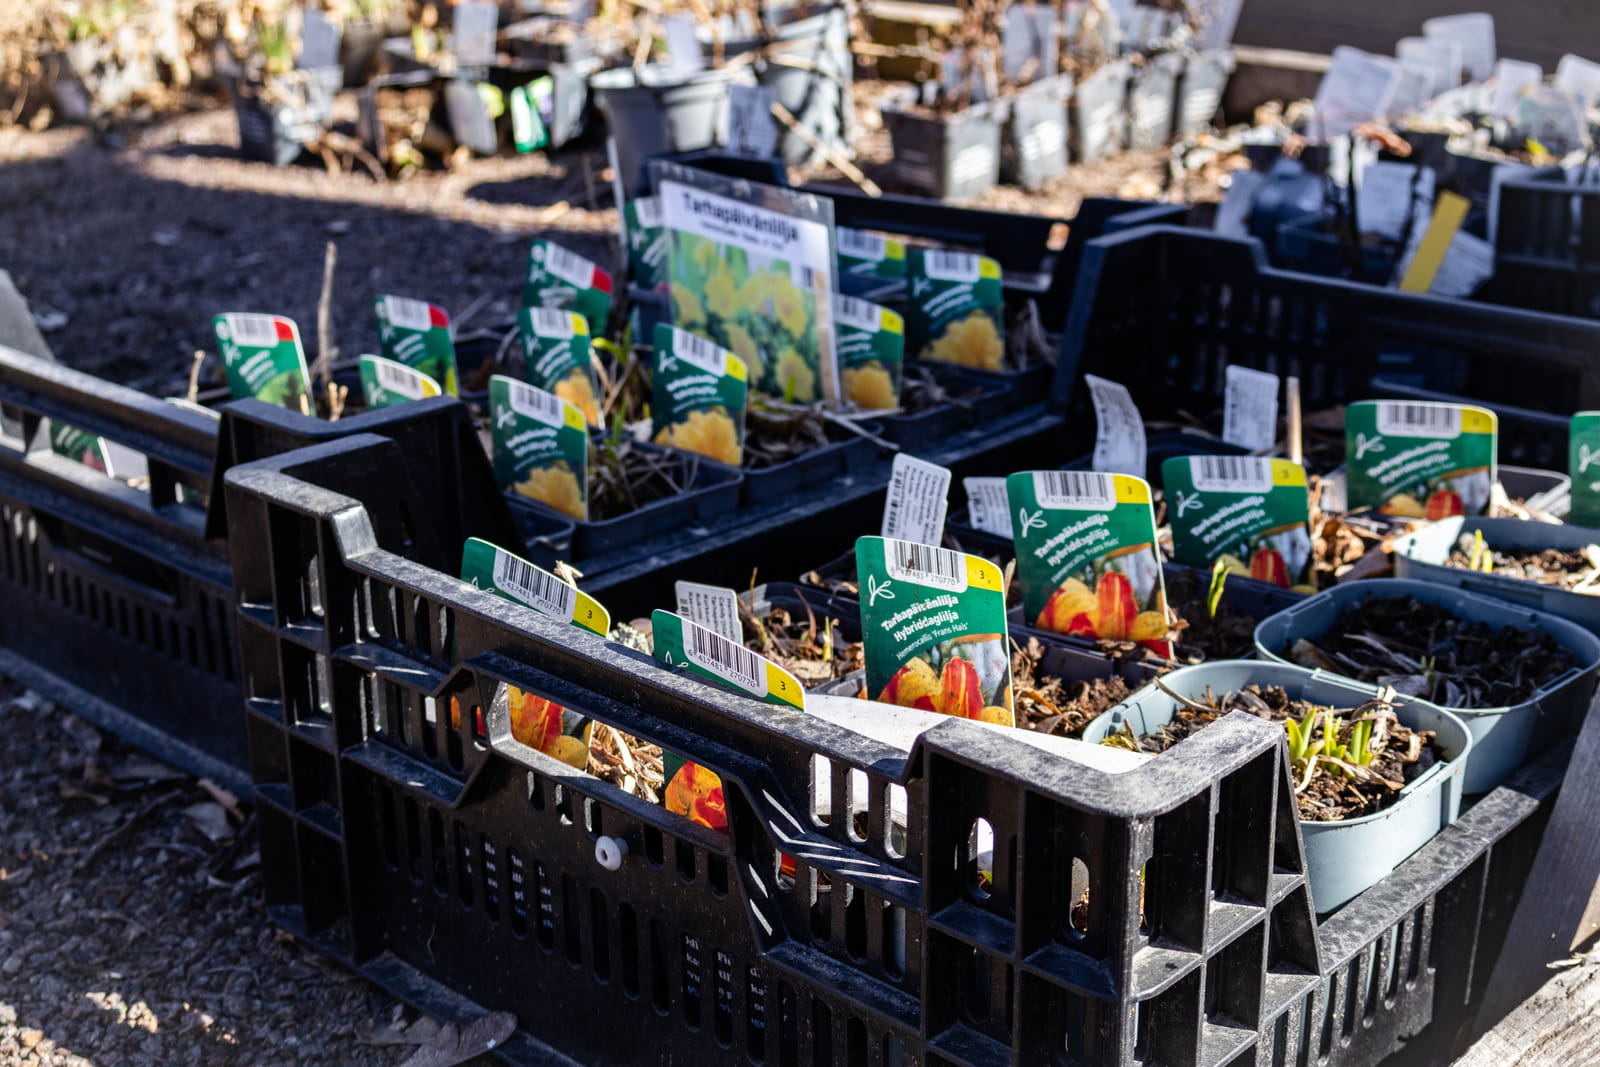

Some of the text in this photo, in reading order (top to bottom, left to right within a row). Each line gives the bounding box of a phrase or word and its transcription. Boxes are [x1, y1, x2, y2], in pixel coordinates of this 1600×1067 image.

[979, 569, 985, 580] 3
[536, 599, 561, 615] 270770
[586, 609, 593, 619] 3
[881, 594, 959, 631] Tarhapäivänlilja
[893, 610, 959, 642] Hybriddaglilja
[896, 633, 932, 661] Hemerocallis
[698, 655, 723, 672] 417481
[729, 669, 756, 688] 270770
[780, 680, 786, 691] 3
